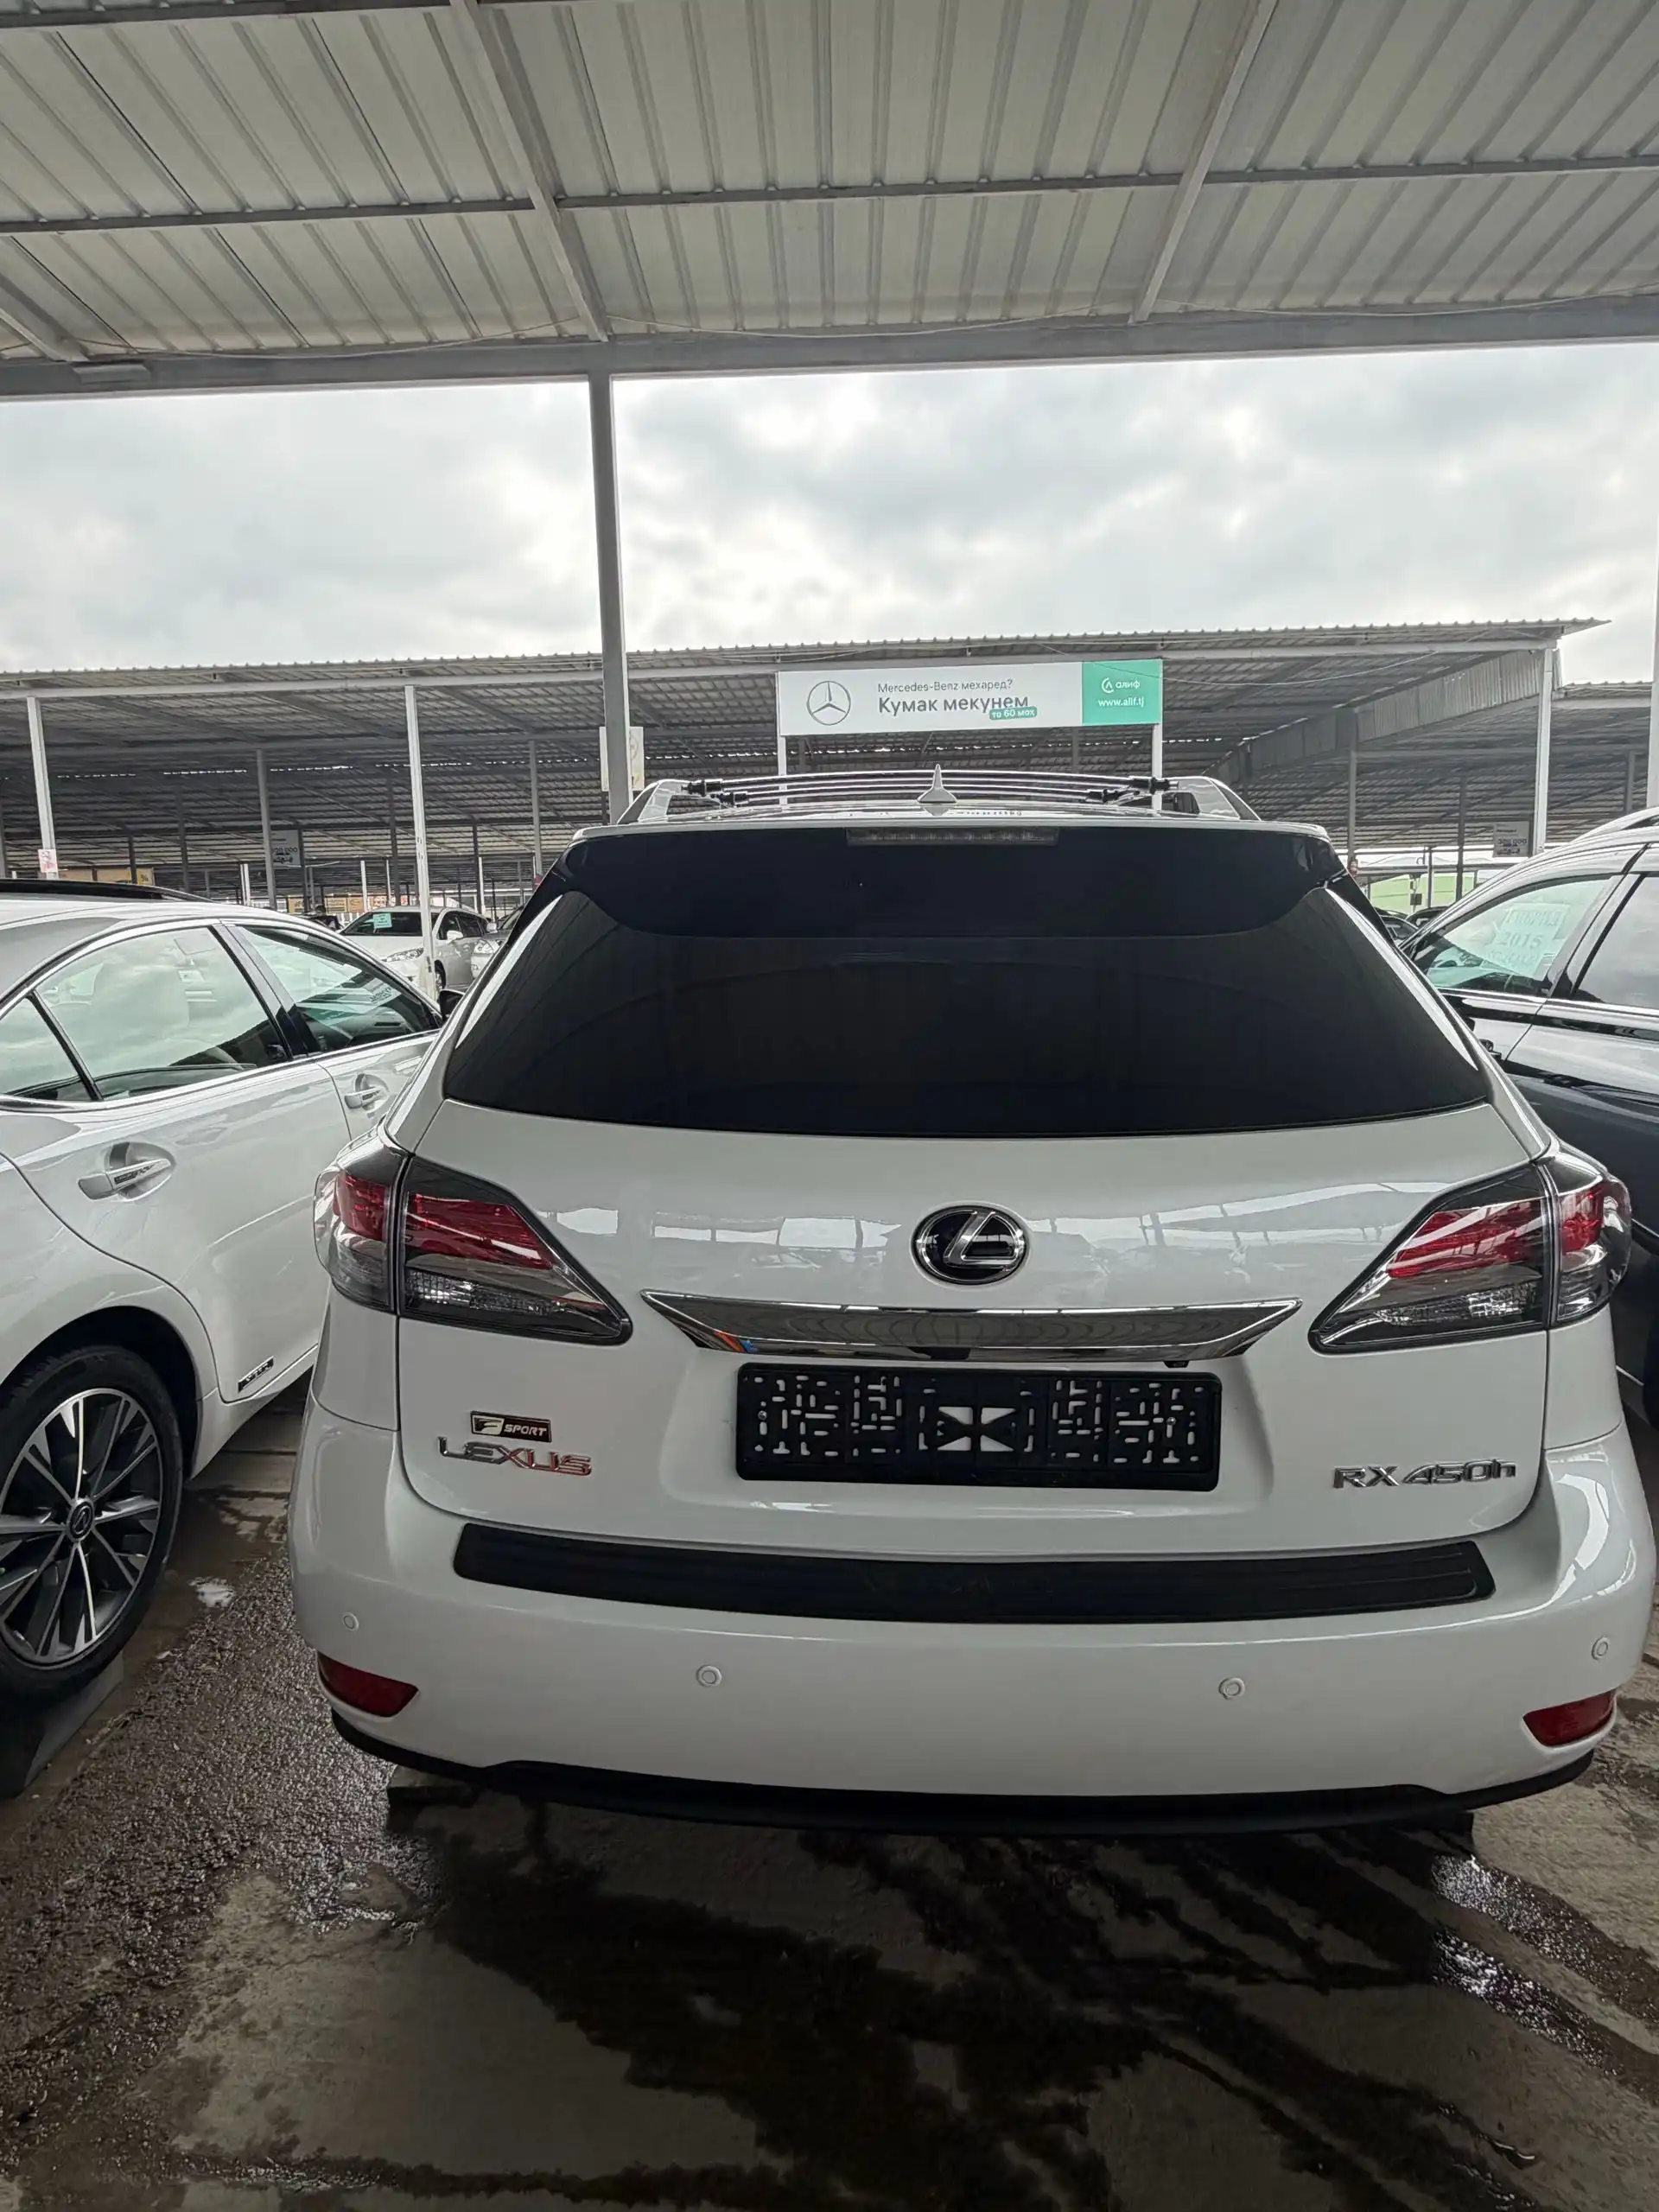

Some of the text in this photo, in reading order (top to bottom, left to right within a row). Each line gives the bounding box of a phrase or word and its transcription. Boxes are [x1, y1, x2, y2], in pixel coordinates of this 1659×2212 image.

[878, 678, 1014, 693] Mercedes-Benz мехаред?
[1115, 679, 1141, 690] алиф
[878, 695, 1029, 716] Кумак мекунем
[1097, 696, 1145, 708] www.alif.tj
[1004, 709, 1015, 717] 60
[503, 1423, 548, 1436] SPORT
[437, 1436, 593, 1476] LEXUS
[1333, 1458, 1516, 1489] RX 450h
